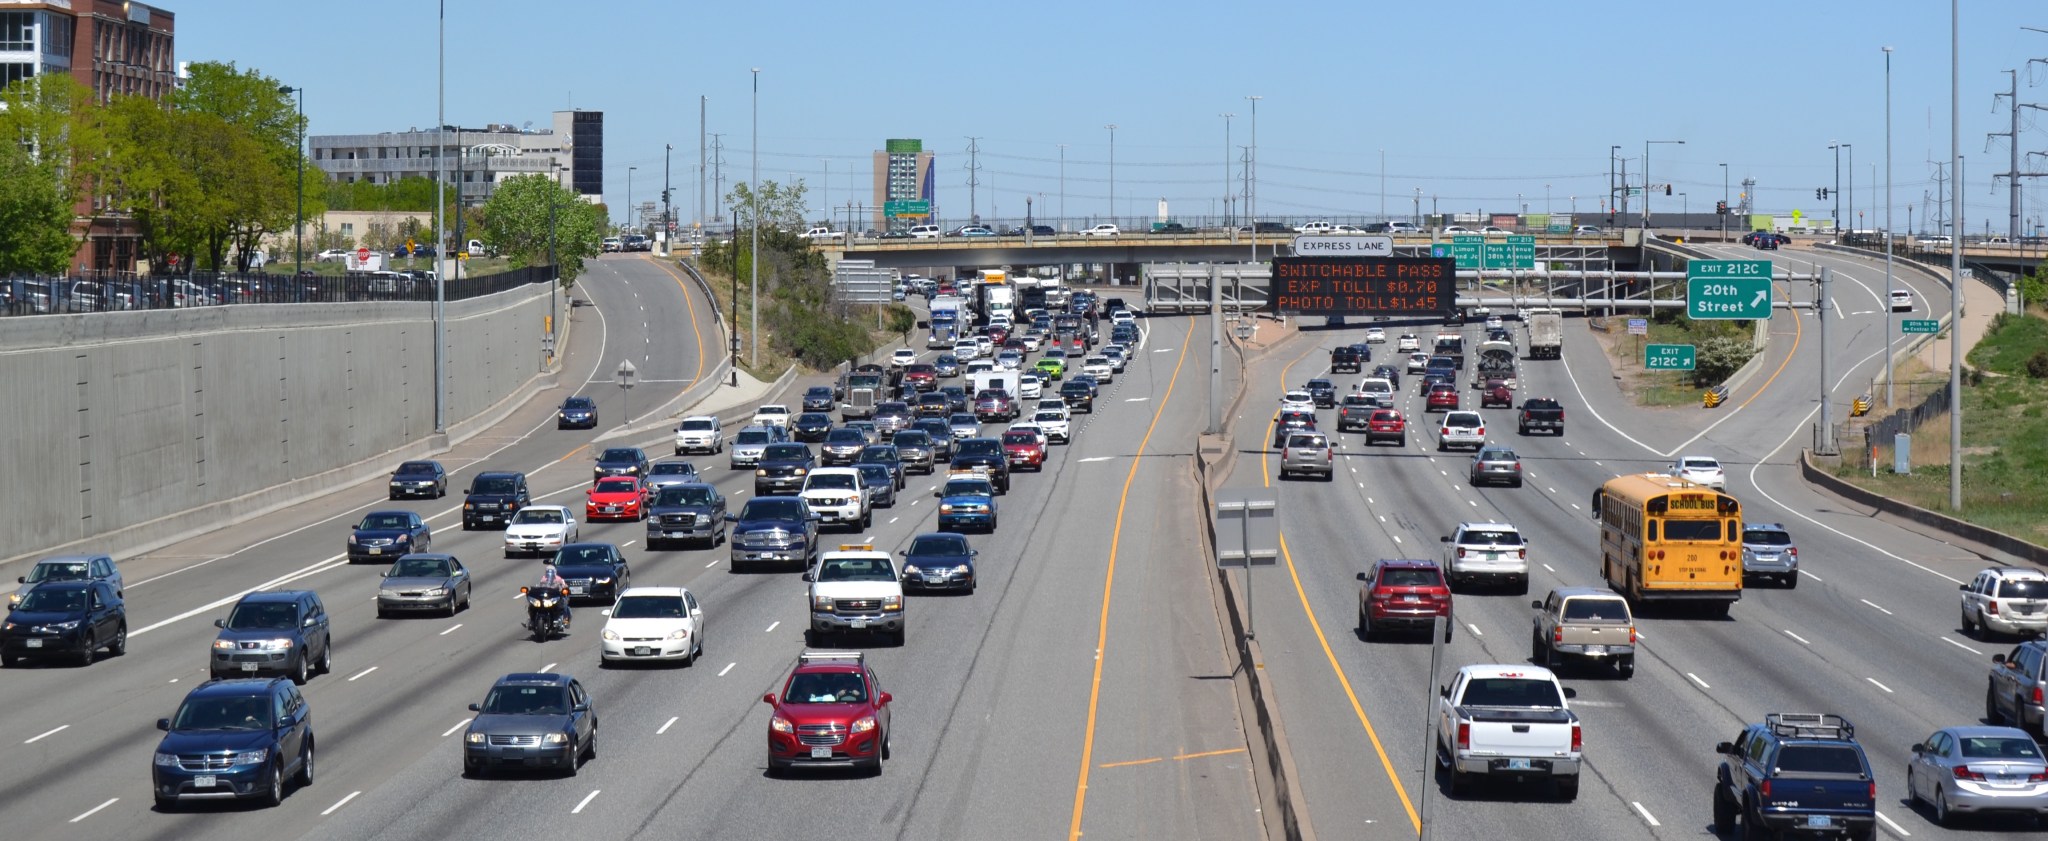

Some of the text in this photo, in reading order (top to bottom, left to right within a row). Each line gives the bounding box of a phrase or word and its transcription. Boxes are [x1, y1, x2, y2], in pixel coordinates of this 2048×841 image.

[1303, 242, 1384, 250] EXPRESS LANE
[1279, 264, 1442, 277] SWITCHABLE PASS
[1701, 264, 1759, 274] EXIT 212C
[1288, 280, 1437, 293] EXP TOLL $0.70
[1703, 284, 1738, 296] 20th
[1278, 296, 1334, 309] PHOTO
[1698, 301, 1744, 312] Street
[1650, 356, 1678, 366] 212C
[1670, 500, 1714, 509] SCHOOL BUS
